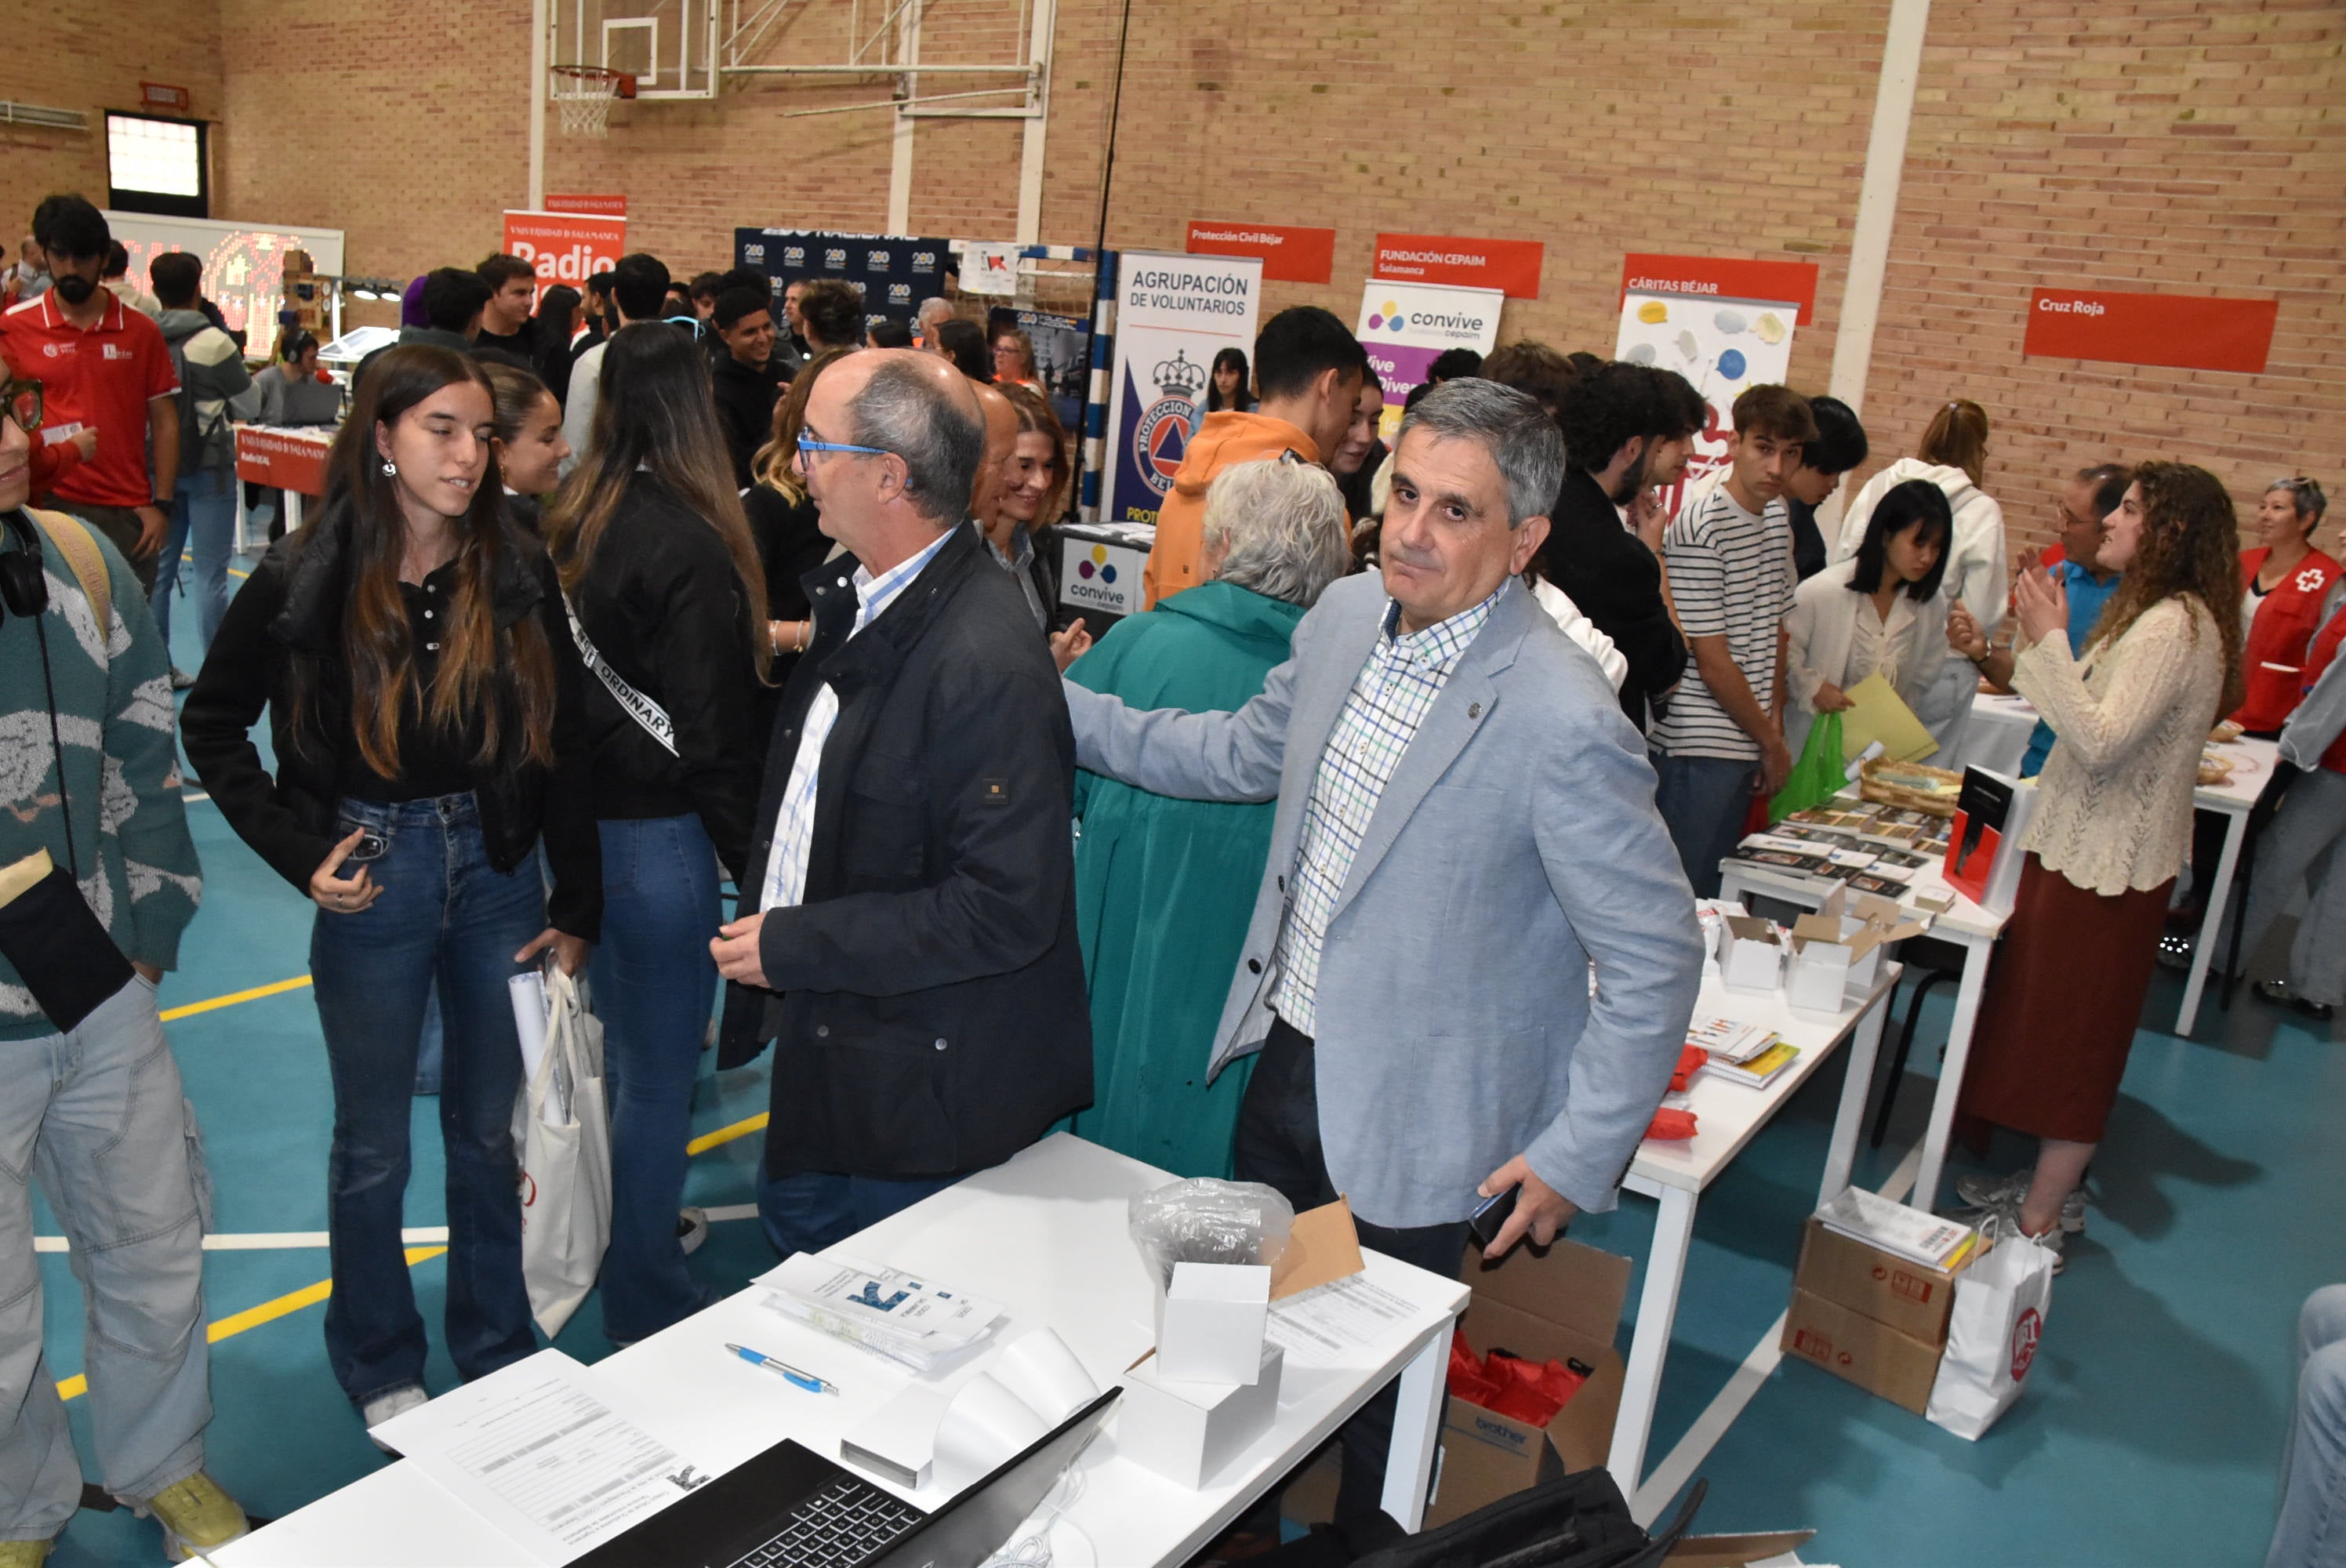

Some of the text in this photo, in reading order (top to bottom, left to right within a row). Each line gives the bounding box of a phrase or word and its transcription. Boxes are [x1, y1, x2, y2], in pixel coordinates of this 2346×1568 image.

[1192, 229, 1284, 245] Protección Civil Béjar
[512, 241, 616, 281] Radio
[1380, 249, 1486, 267] FUNDACIÓN CEPAIM
[1379, 263, 1425, 275] Salamanca
[1132, 270, 1248, 296] AGRUPACIÓN
[1629, 276, 1719, 295] CÁRITAS BÉJAR
[1130, 292, 1245, 315] DE VOLUNTARIOS
[2039, 298, 2105, 317] Cruz Roja
[1411, 312, 1483, 331] convive
[1445, 329, 1480, 340] cepaim
[1139, 401, 1192, 452] PROTECCION
[1127, 506, 1158, 524] PROT
[1070, 584, 1124, 604] convive
[601, 666, 674, 738] ORDINARY
[1476, 1417, 1527, 1444] brother
